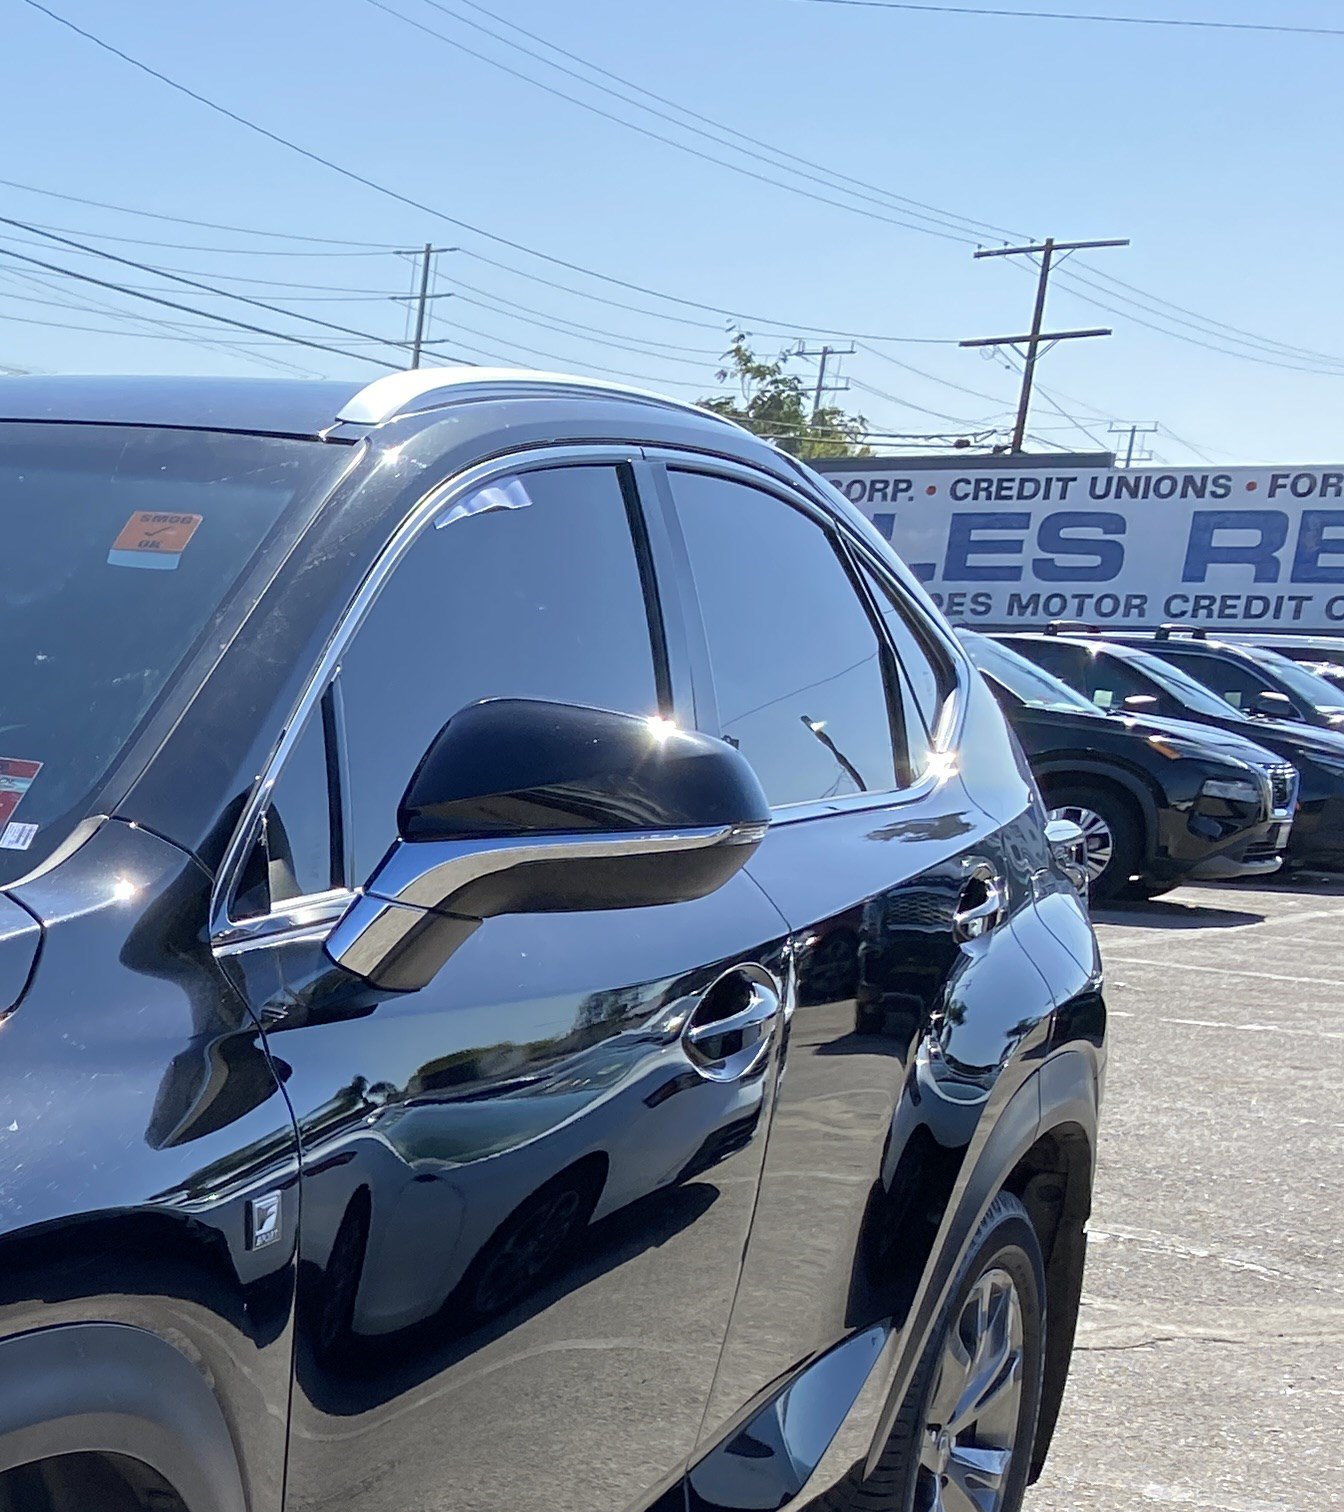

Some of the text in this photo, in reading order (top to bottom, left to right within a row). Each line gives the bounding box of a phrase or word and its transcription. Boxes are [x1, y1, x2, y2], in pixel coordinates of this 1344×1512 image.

[949, 477, 1077, 501] CREDIT
[1088, 474, 1232, 499] UNIONS
[1006, 593, 1148, 618] MOTOR
[1164, 594, 1313, 620] CREDIT
